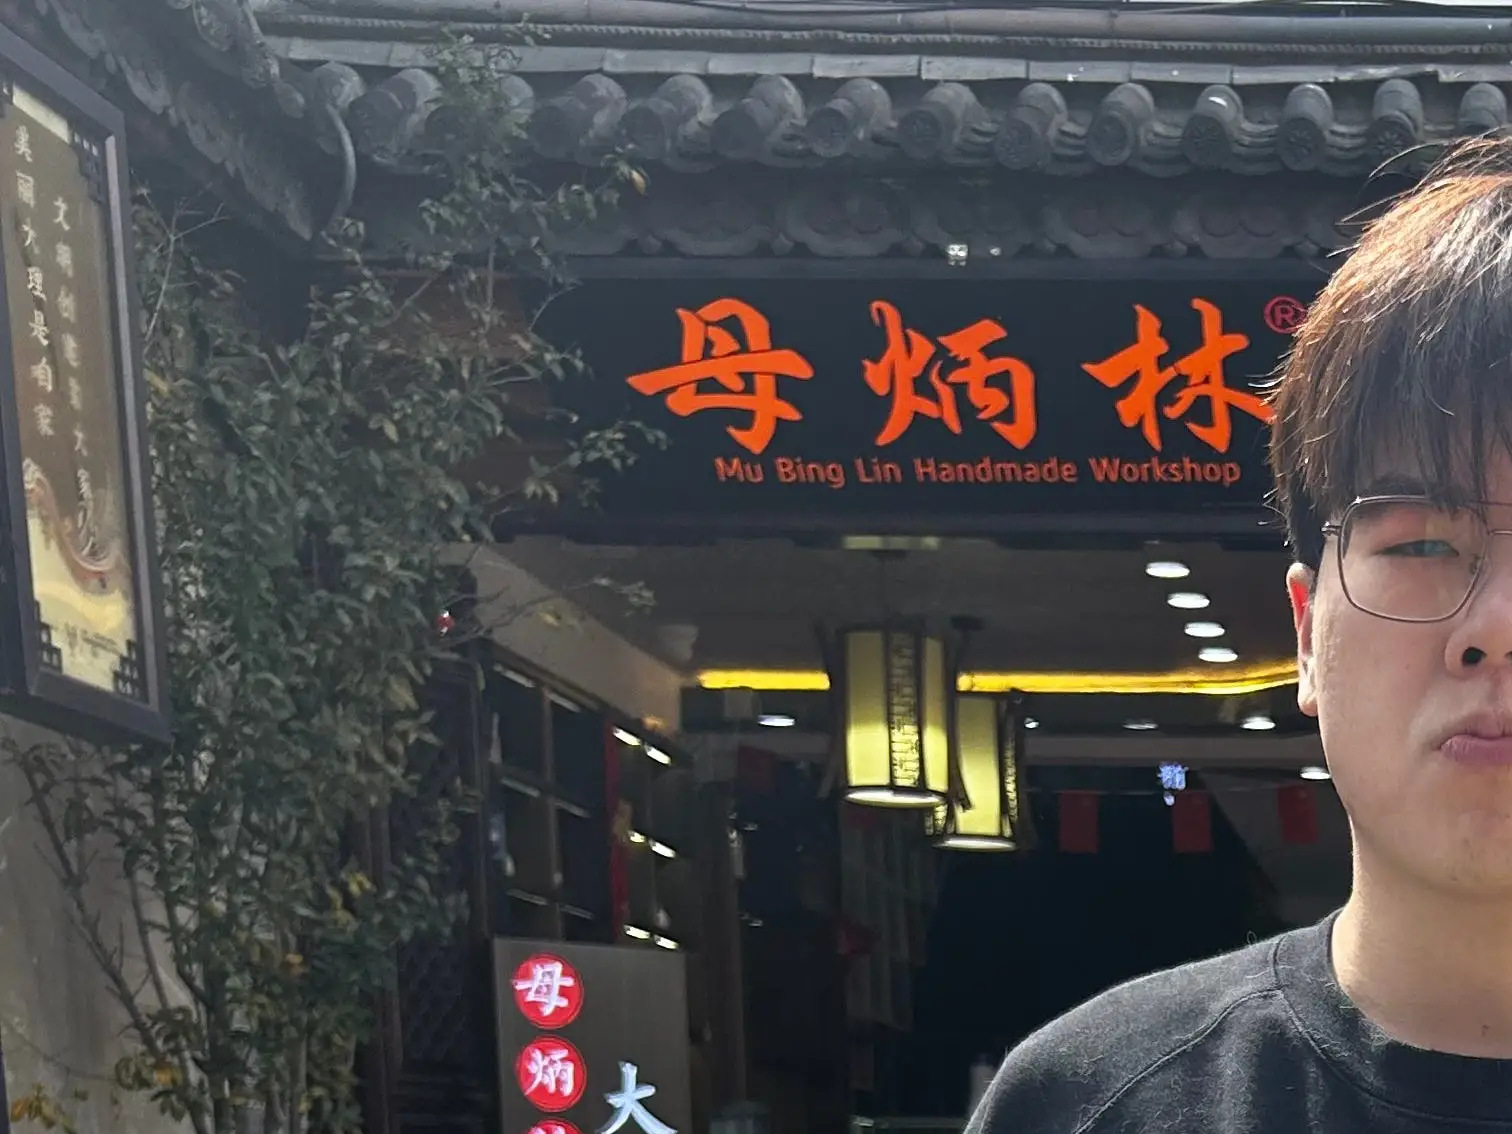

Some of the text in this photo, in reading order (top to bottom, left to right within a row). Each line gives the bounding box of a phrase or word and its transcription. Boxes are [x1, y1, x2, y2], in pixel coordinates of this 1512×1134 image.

[625, 298, 1278, 454] 母炳林
[714, 455, 1242, 489] Mu Bing Lin Handmade Workshop
